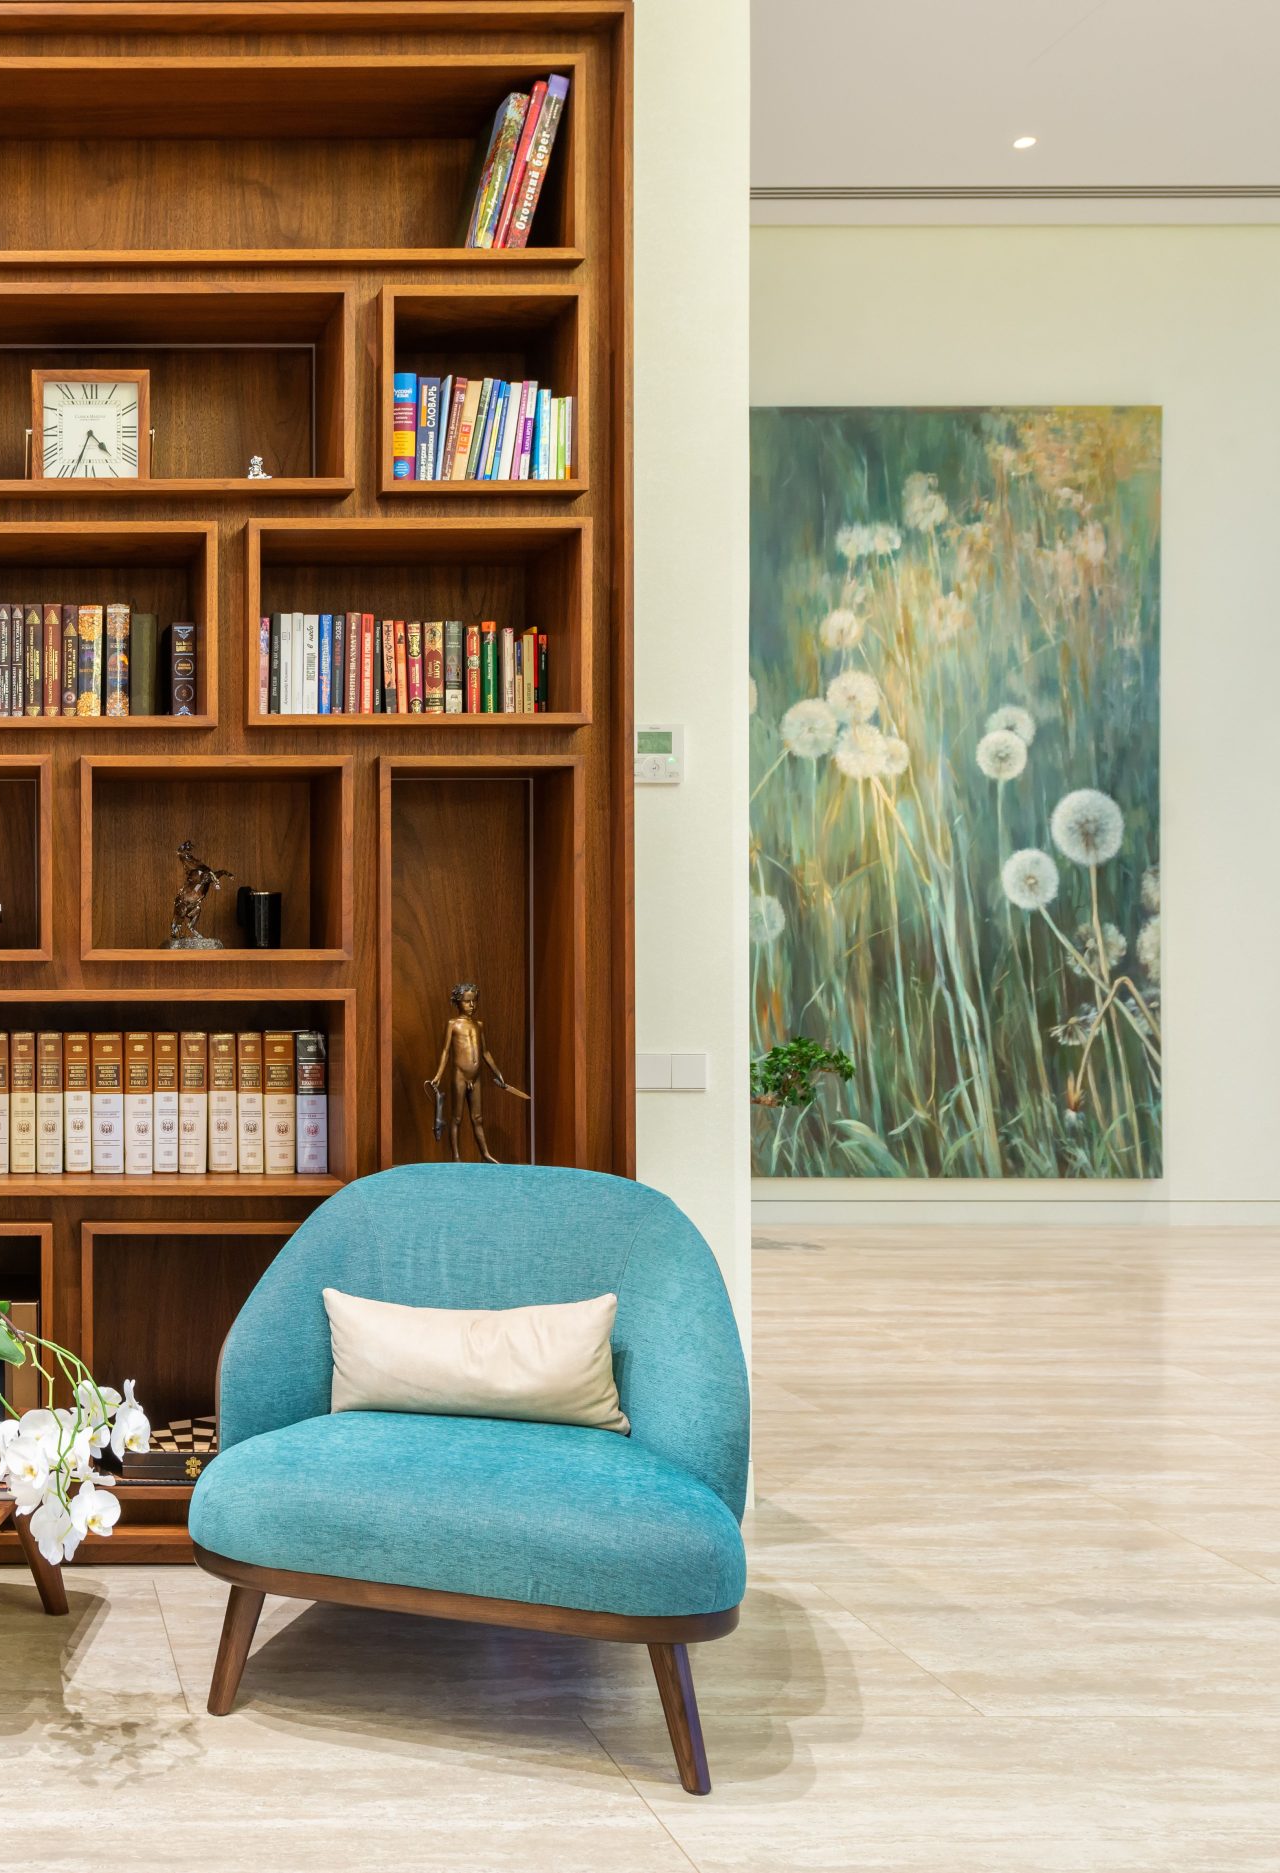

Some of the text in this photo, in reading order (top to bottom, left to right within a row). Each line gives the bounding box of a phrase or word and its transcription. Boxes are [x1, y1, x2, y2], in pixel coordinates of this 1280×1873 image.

[515, 130, 551, 230] Охотский берег
[427, 385, 438, 427] СЛОВАРЬ
[306, 652, 317, 681] ЛЕСТНИЦА
[348, 673, 356, 712] УЧЕБНИК
